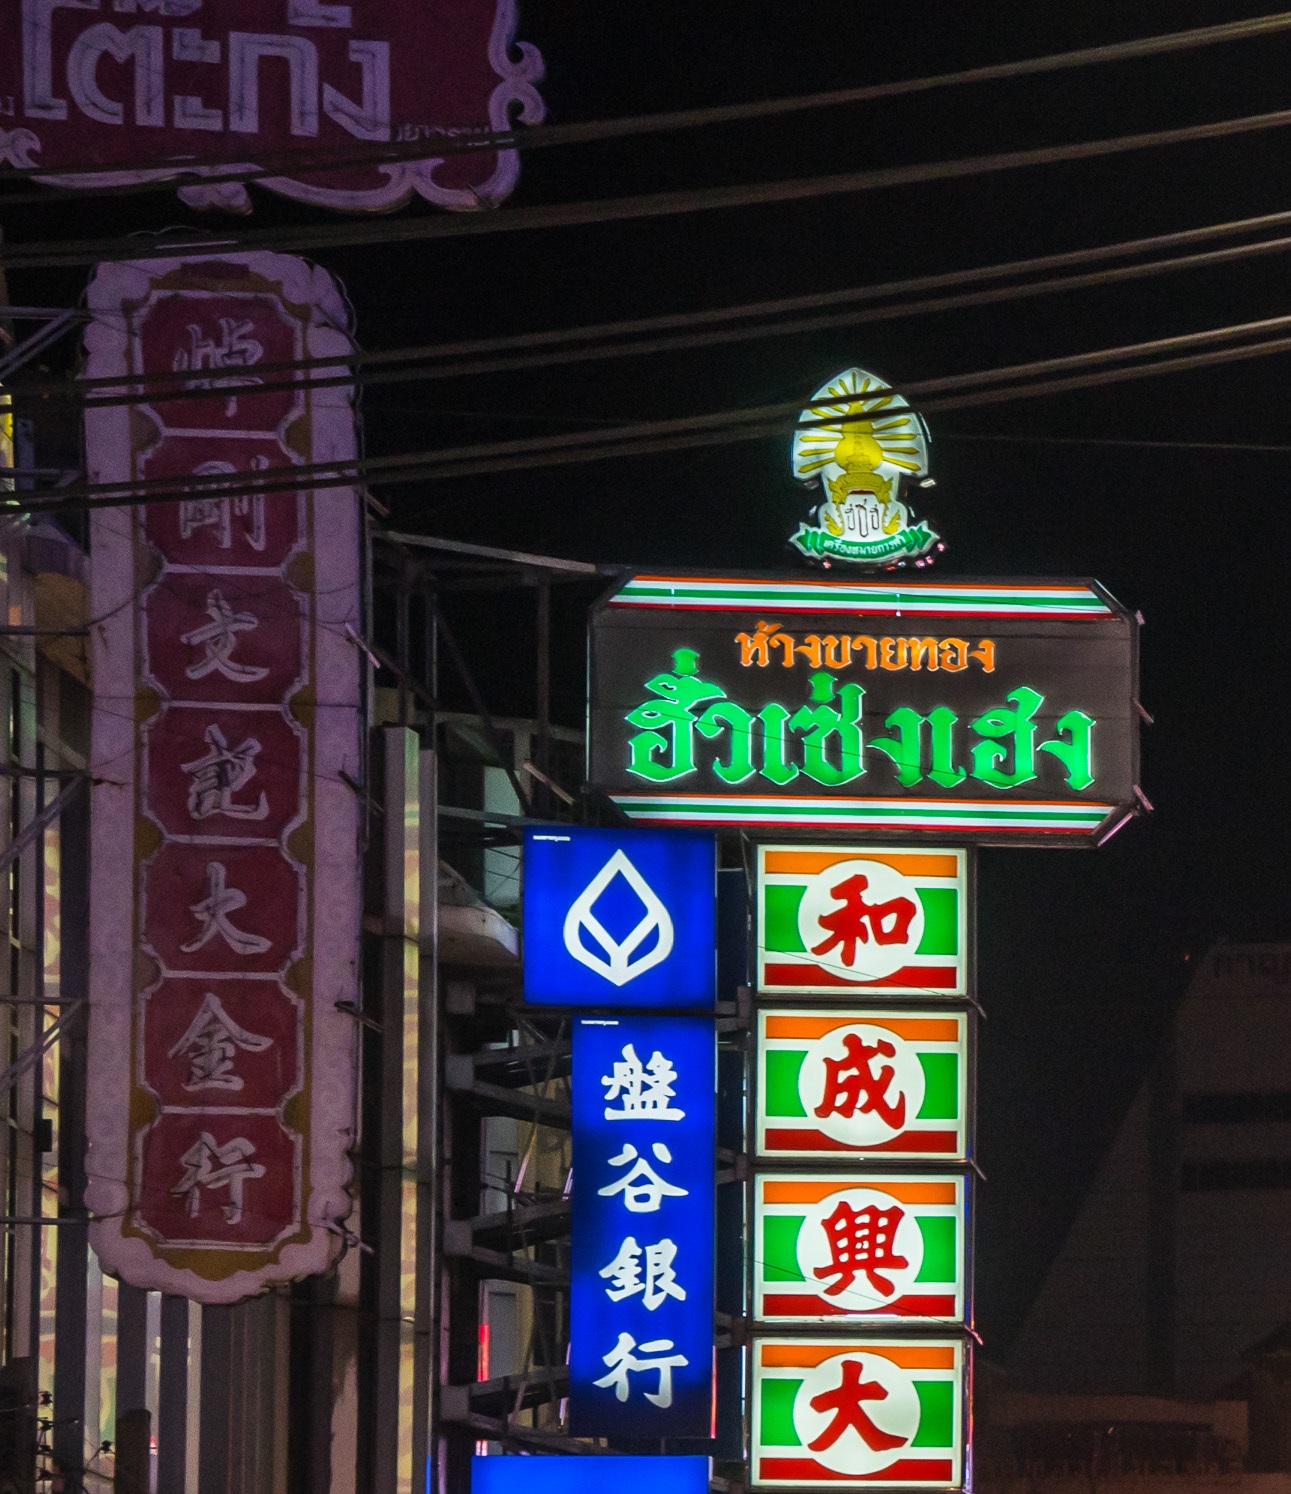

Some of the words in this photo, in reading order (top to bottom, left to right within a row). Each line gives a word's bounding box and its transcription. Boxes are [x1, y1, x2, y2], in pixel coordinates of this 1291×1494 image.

[624, 648, 1097, 791] ฮั่วเซ่งเฮง
[594, 1043, 689, 1408] 盤谷銀行
